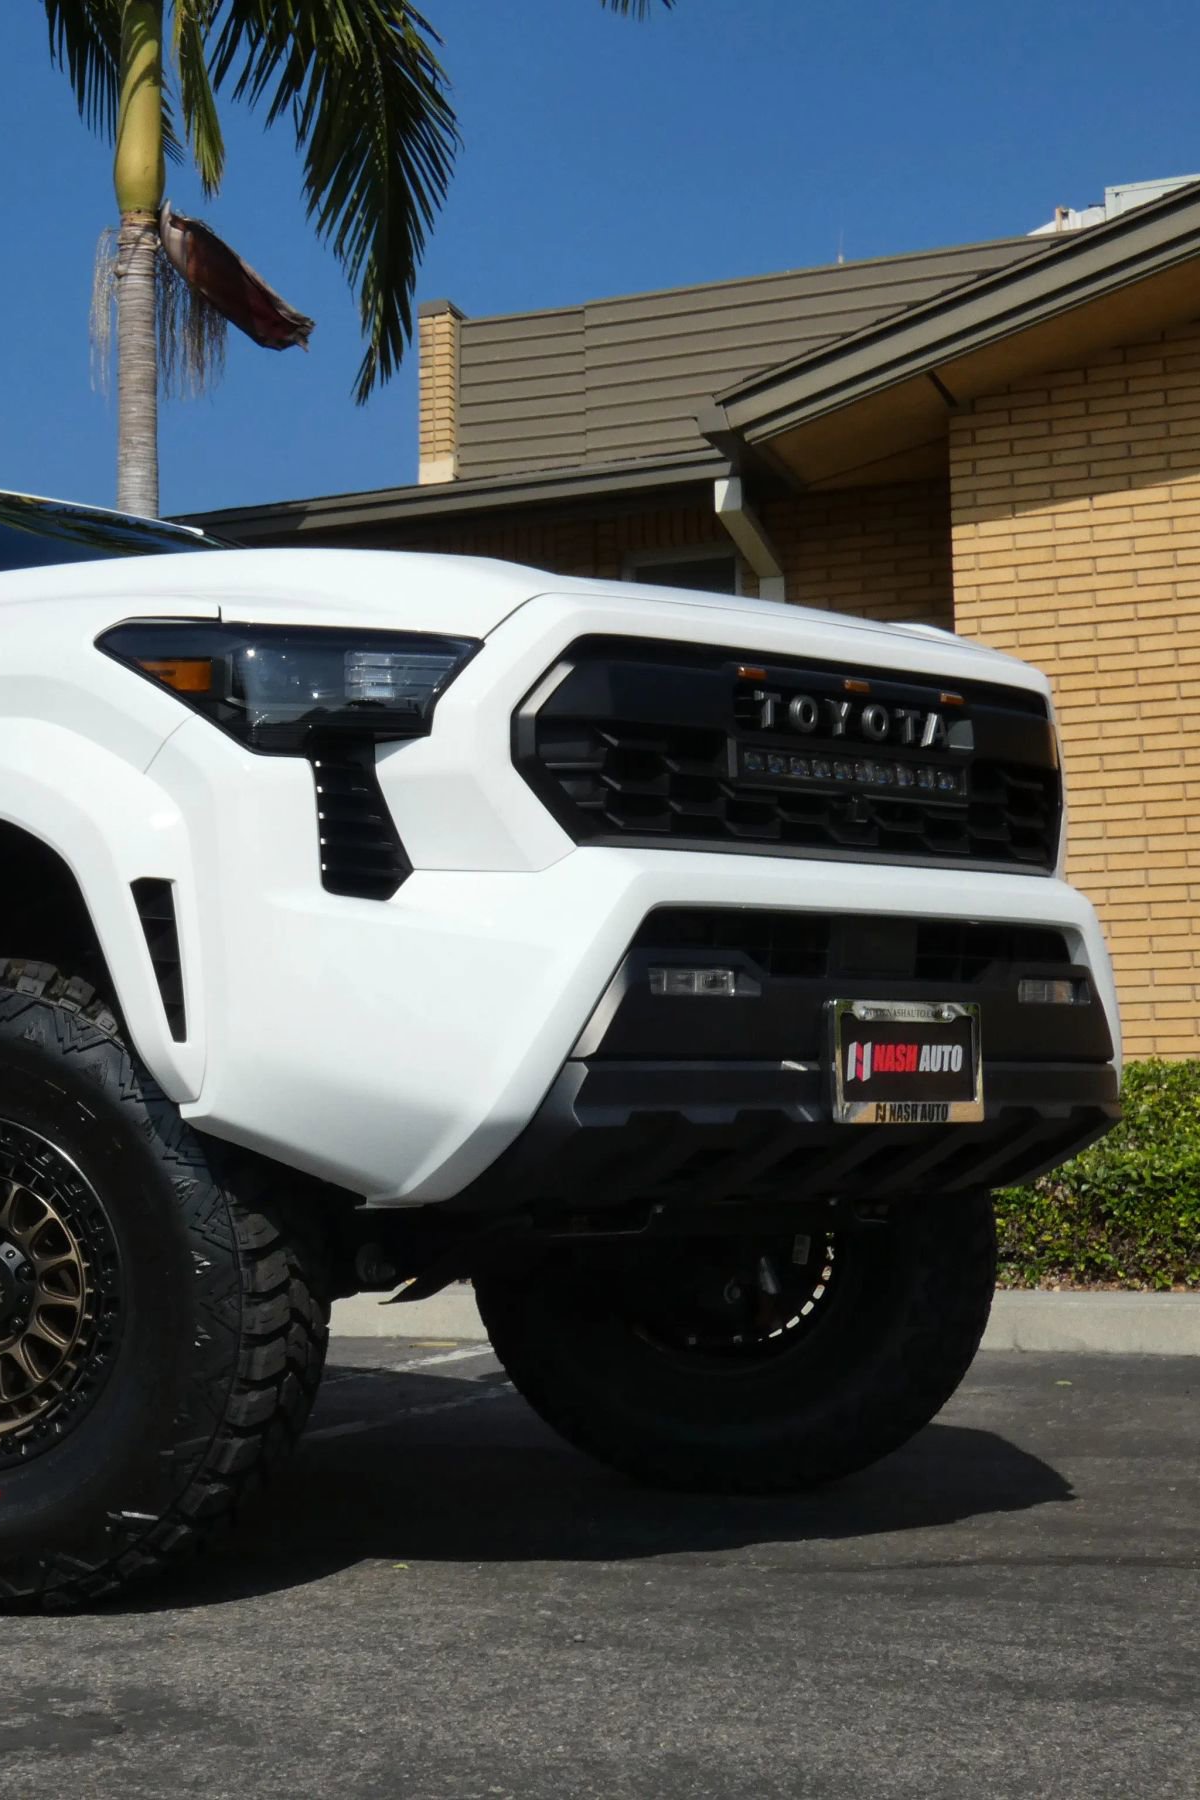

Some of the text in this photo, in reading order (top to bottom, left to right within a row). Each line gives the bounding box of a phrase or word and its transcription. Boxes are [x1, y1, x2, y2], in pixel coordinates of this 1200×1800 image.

[754, 690, 948, 748] TOYOTA
[865, 1007, 942, 1019] WWW.NASHAUTO.C
[873, 1043, 919, 1072] NASH
[919, 1044, 963, 1072] AUTO
[889, 1103, 918, 1122] NASH
[920, 1103, 949, 1122] AUTO
